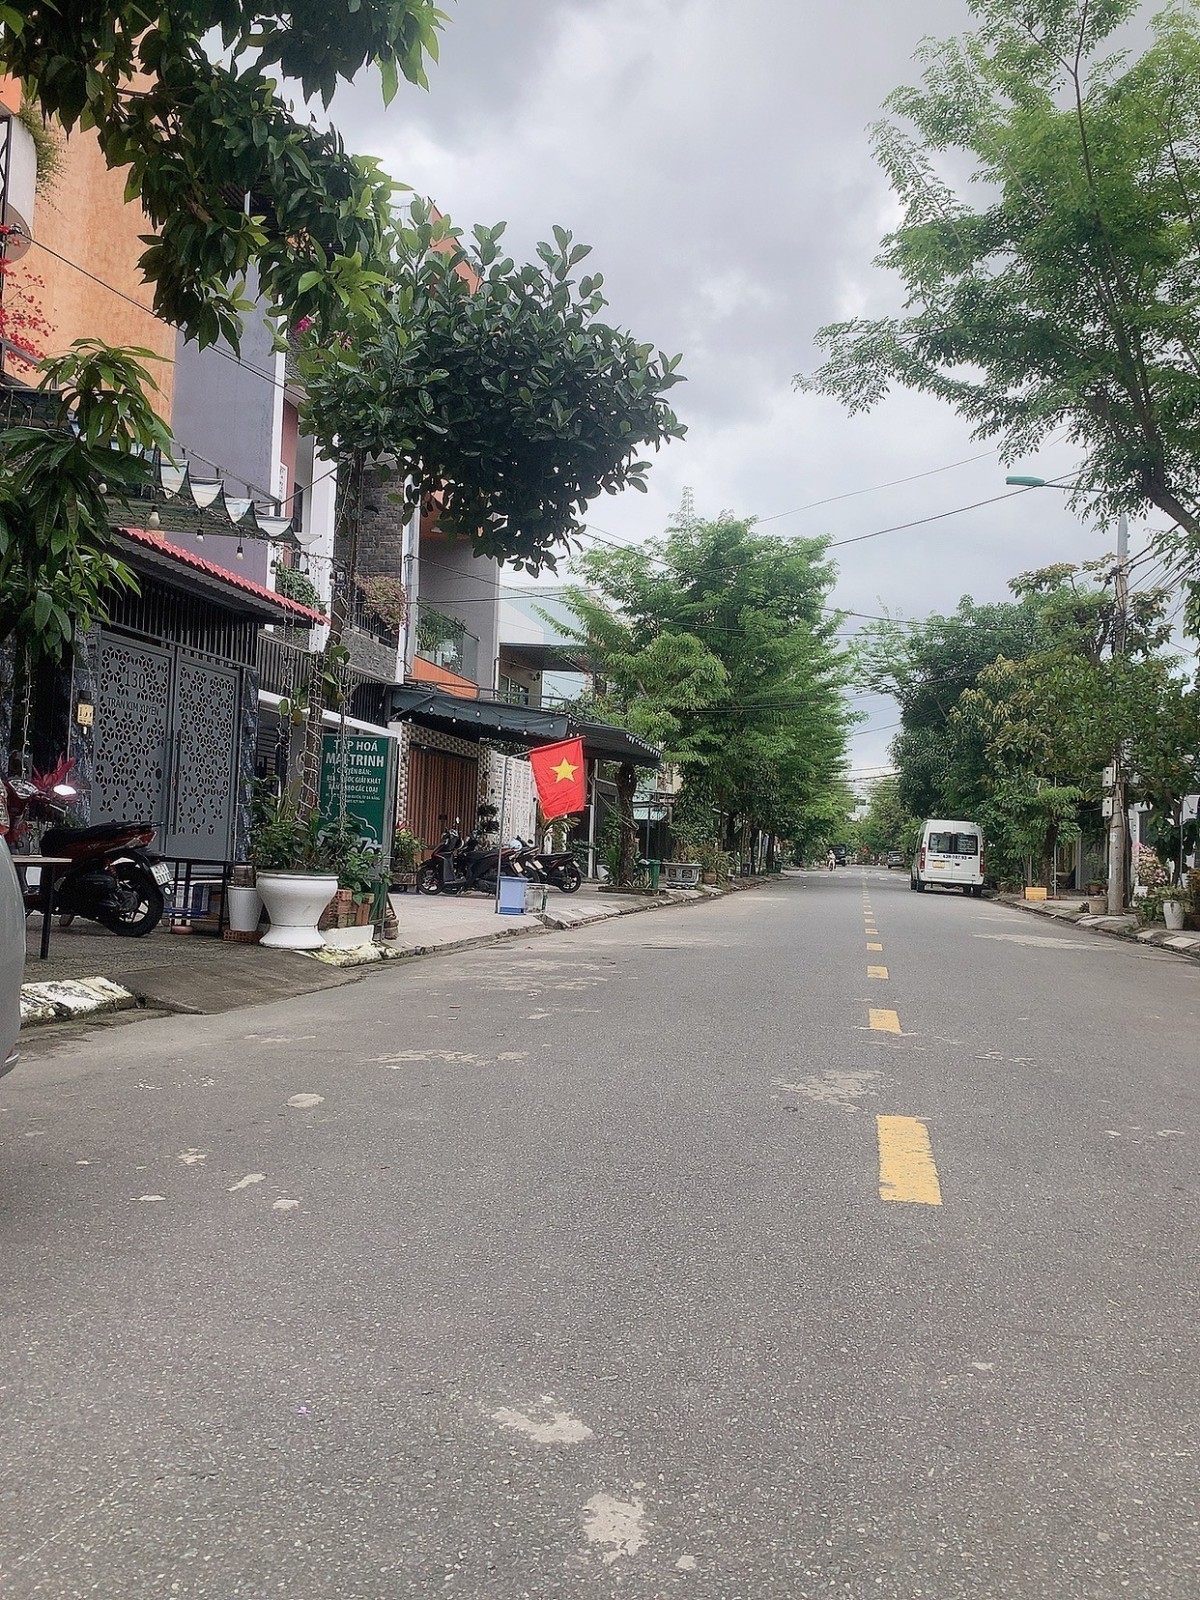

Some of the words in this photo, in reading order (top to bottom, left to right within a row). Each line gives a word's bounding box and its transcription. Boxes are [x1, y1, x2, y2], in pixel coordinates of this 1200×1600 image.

[124, 670, 146, 690] 130
[126, 701, 139, 713] KIM
[356, 740, 378, 752] HOÁ
[349, 753, 385, 767] TRINH
